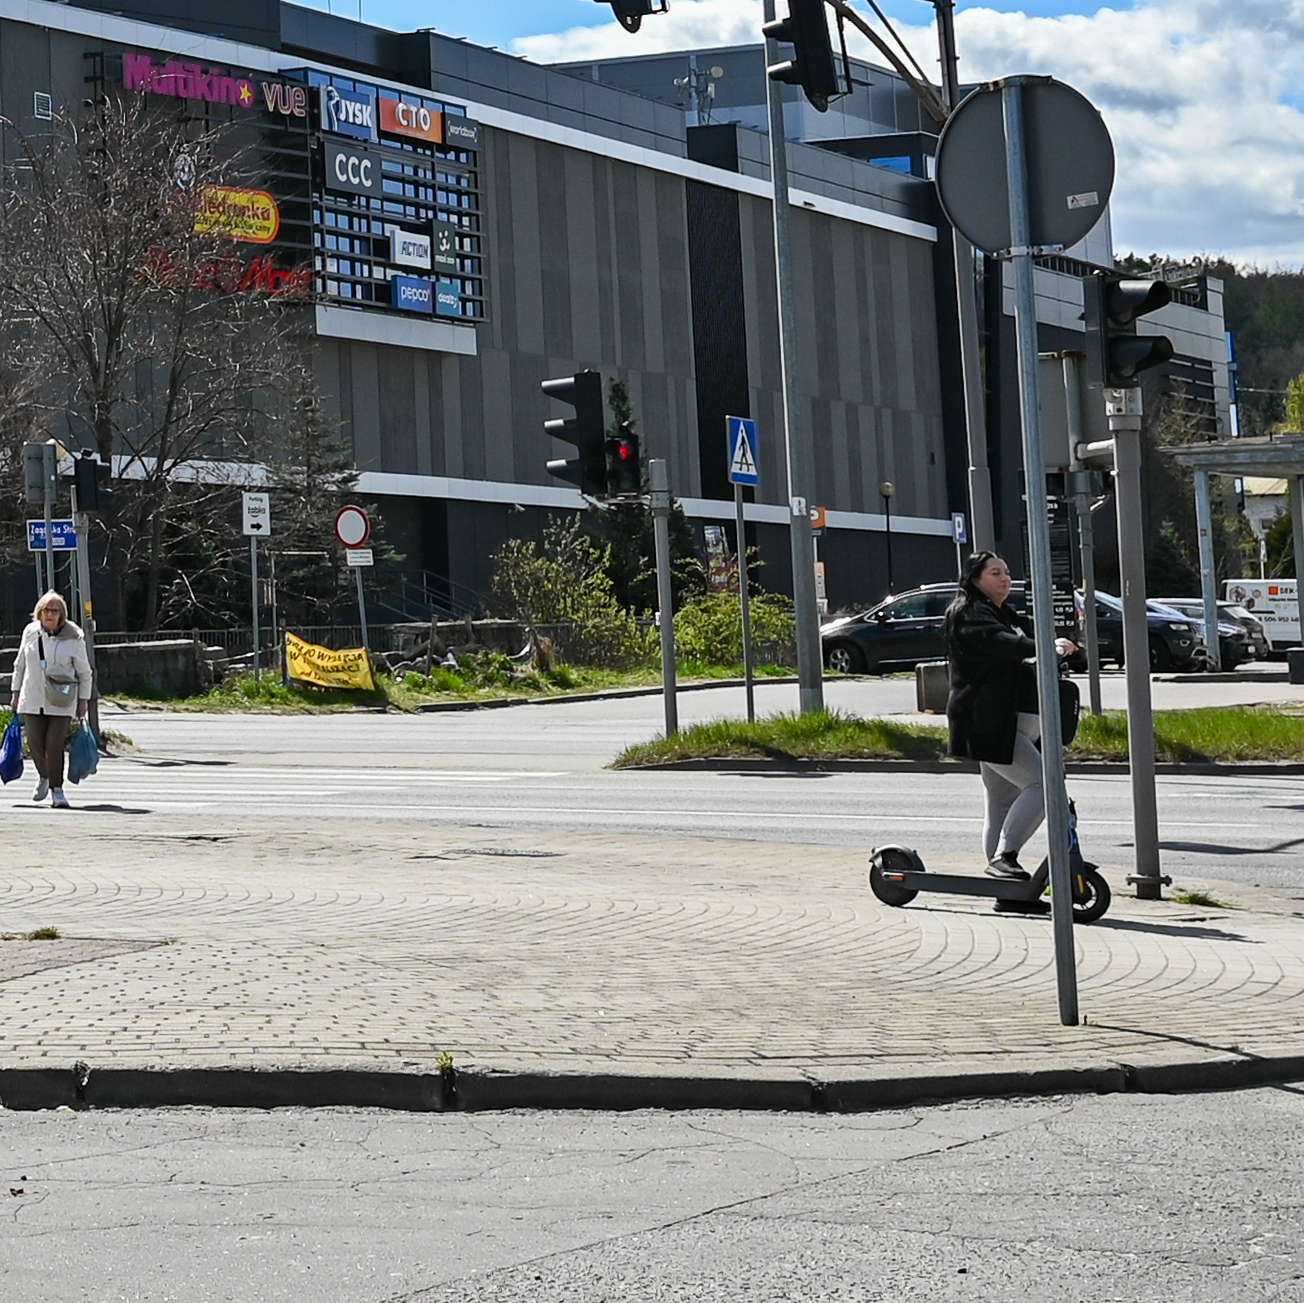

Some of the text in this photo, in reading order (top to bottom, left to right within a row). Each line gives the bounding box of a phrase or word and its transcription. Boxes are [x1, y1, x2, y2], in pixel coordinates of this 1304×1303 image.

[123, 52, 255, 108] Multikino
[339, 98, 372, 127] JYSK
[396, 101, 431, 132] CTO
[335, 152, 373, 188] CCC
[401, 240, 429, 259] ACTION
[400, 285, 429, 303] pepco
[954, 516, 964, 540] P
